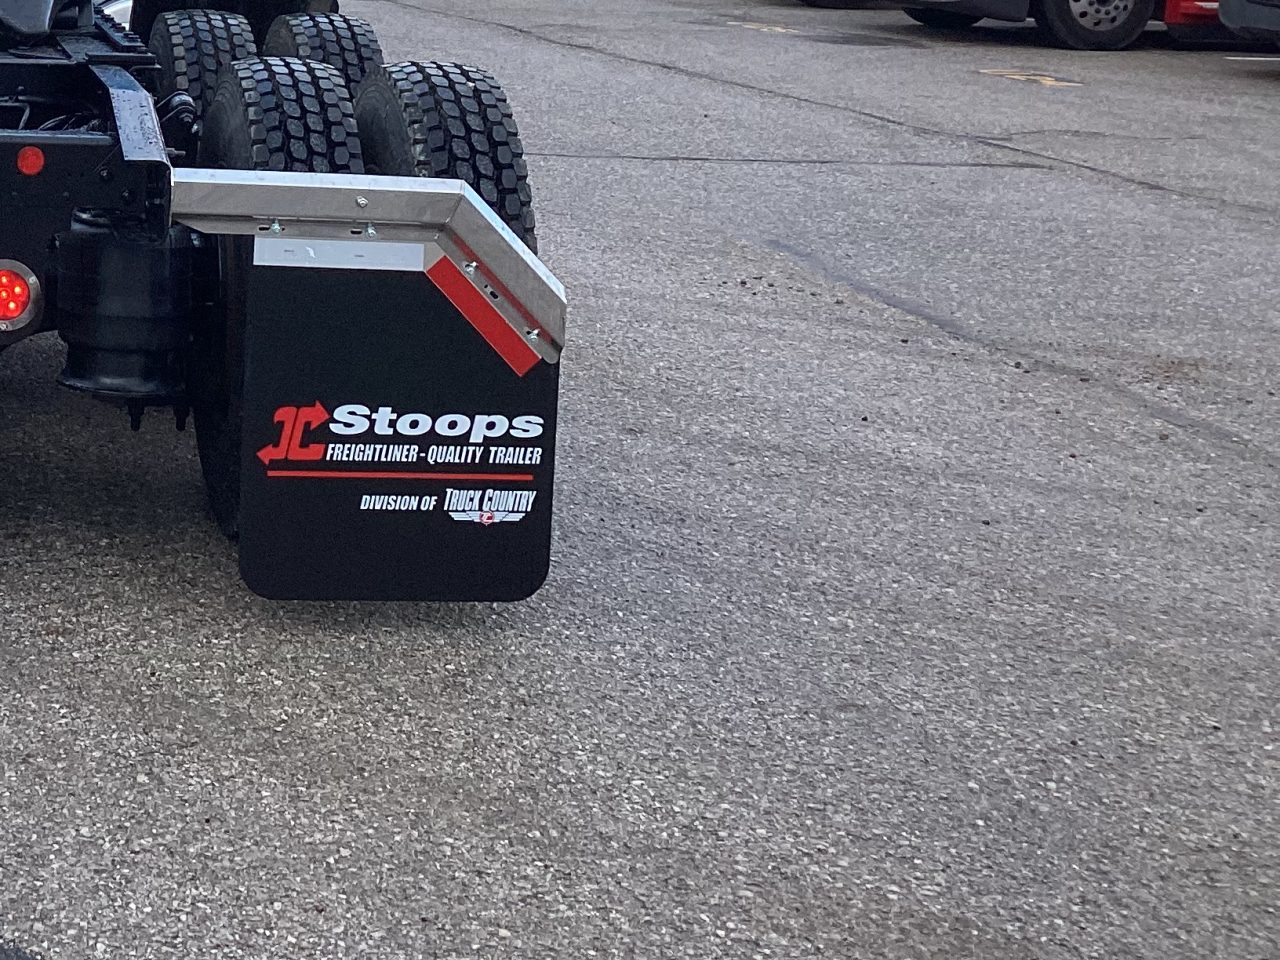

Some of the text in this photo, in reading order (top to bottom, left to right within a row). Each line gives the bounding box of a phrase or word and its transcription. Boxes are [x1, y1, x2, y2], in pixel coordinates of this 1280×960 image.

[328, 404, 544, 443] Stoops
[488, 446, 542, 465] TRAILER
[360, 488, 537, 512] DIVISION OF TRUCK COUNTRY
